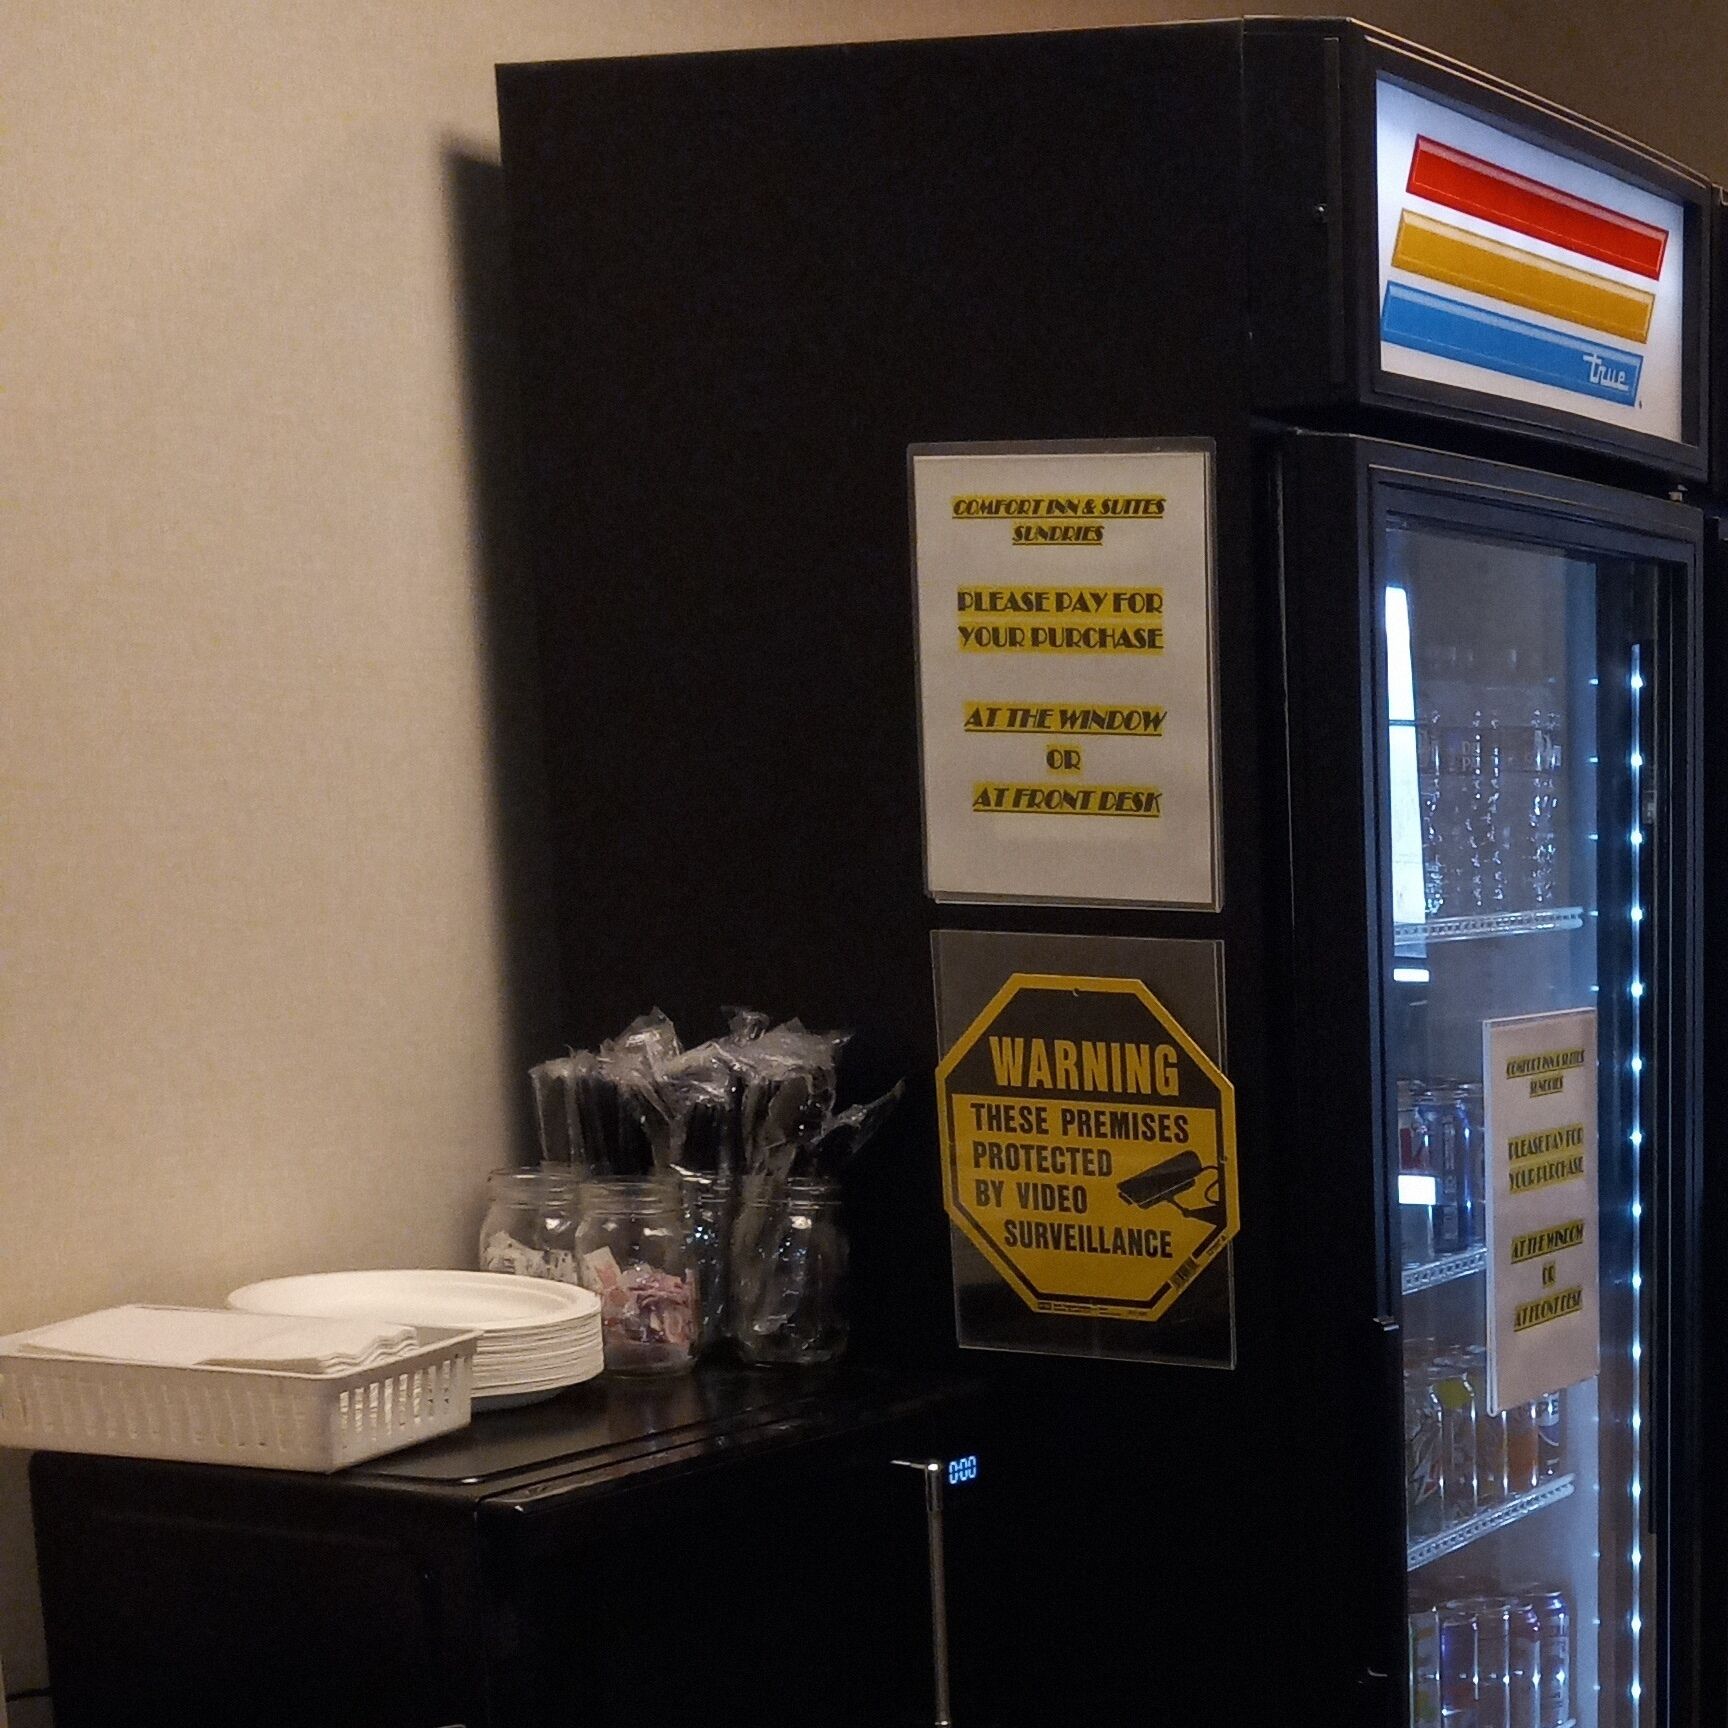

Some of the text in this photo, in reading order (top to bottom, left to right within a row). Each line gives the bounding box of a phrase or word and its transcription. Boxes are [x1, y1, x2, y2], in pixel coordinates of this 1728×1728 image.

[1583, 354, 1630, 391] true
[953, 498, 1165, 517] COMFORT INN & SUITES
[1012, 525, 1105, 543] SUNDRIES
[958, 591, 1163, 614] PLEASE PAY FOR
[958, 626, 1163, 649] YOUR PURCHASE
[965, 707, 1167, 732] AT THE WINDOW
[1047, 749, 1081, 770] OR
[973, 787, 1162, 813] AT FRONT DESK
[988, 1035, 1180, 1096] WARNING
[970, 1102, 1189, 1143] THESE PREMISES
[973, 1141, 1113, 1177] PROTECTED
[975, 1179, 1088, 1214] BY VIDEO
[1004, 1219, 1173, 1259] SURVEILLANCE
